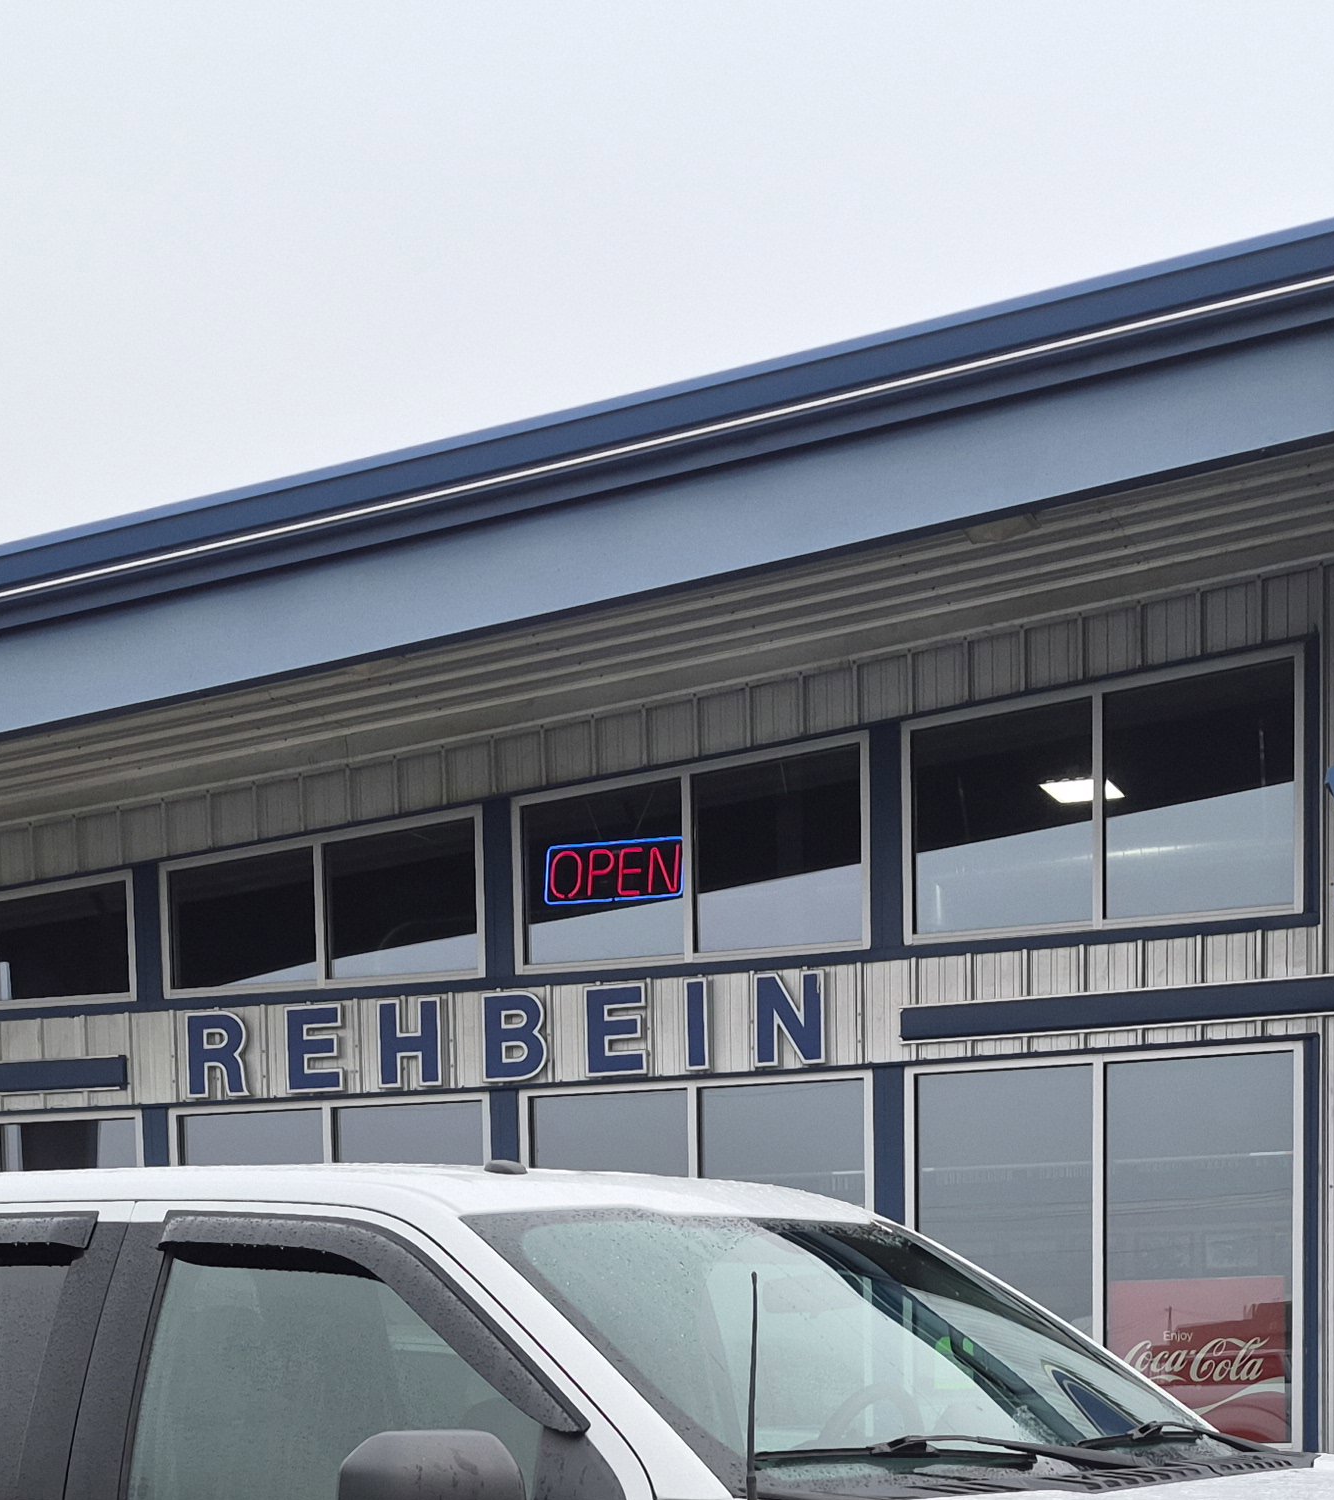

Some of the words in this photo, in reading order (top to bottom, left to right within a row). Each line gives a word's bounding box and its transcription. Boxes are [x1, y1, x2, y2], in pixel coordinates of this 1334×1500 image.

[549, 844, 681, 899] OPEN
[183, 967, 827, 1099] REHBEIN
[1163, 1330, 1193, 1343] Enjoy
